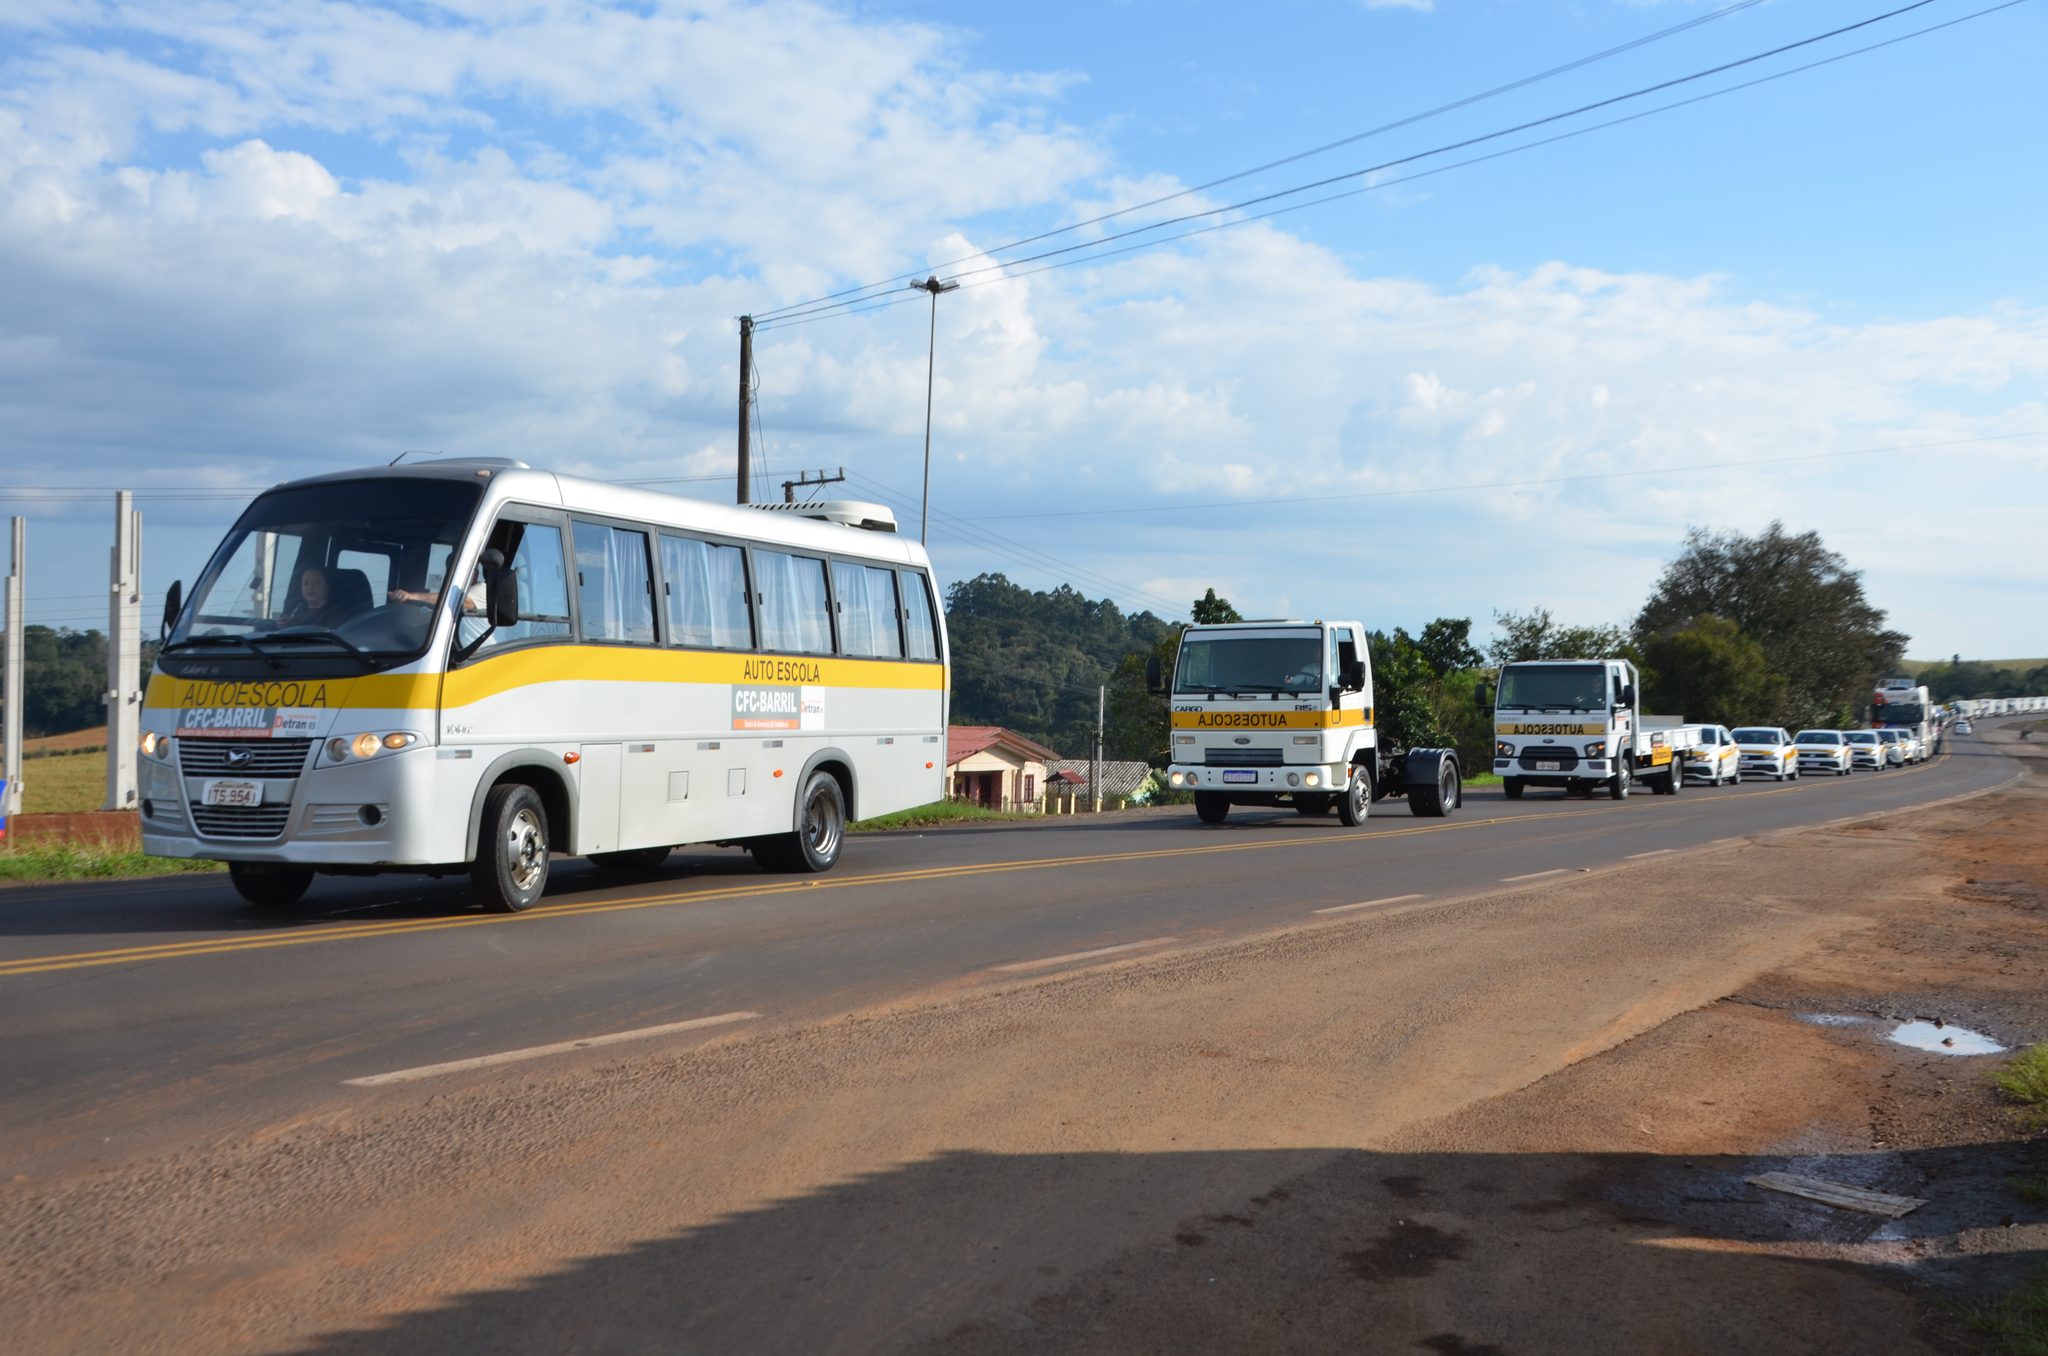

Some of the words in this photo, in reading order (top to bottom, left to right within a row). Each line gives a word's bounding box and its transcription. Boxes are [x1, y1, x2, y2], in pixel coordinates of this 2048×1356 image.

[743, 659, 774, 680] AUTO
[777, 661, 820, 682] ESCOLA
[181, 682, 327, 708] AUTOESCOLA
[735, 690, 797, 712] CFC-BARRIL
[185, 708, 267, 728] CFC-BARRIL
[273, 715, 308, 730] Detran
